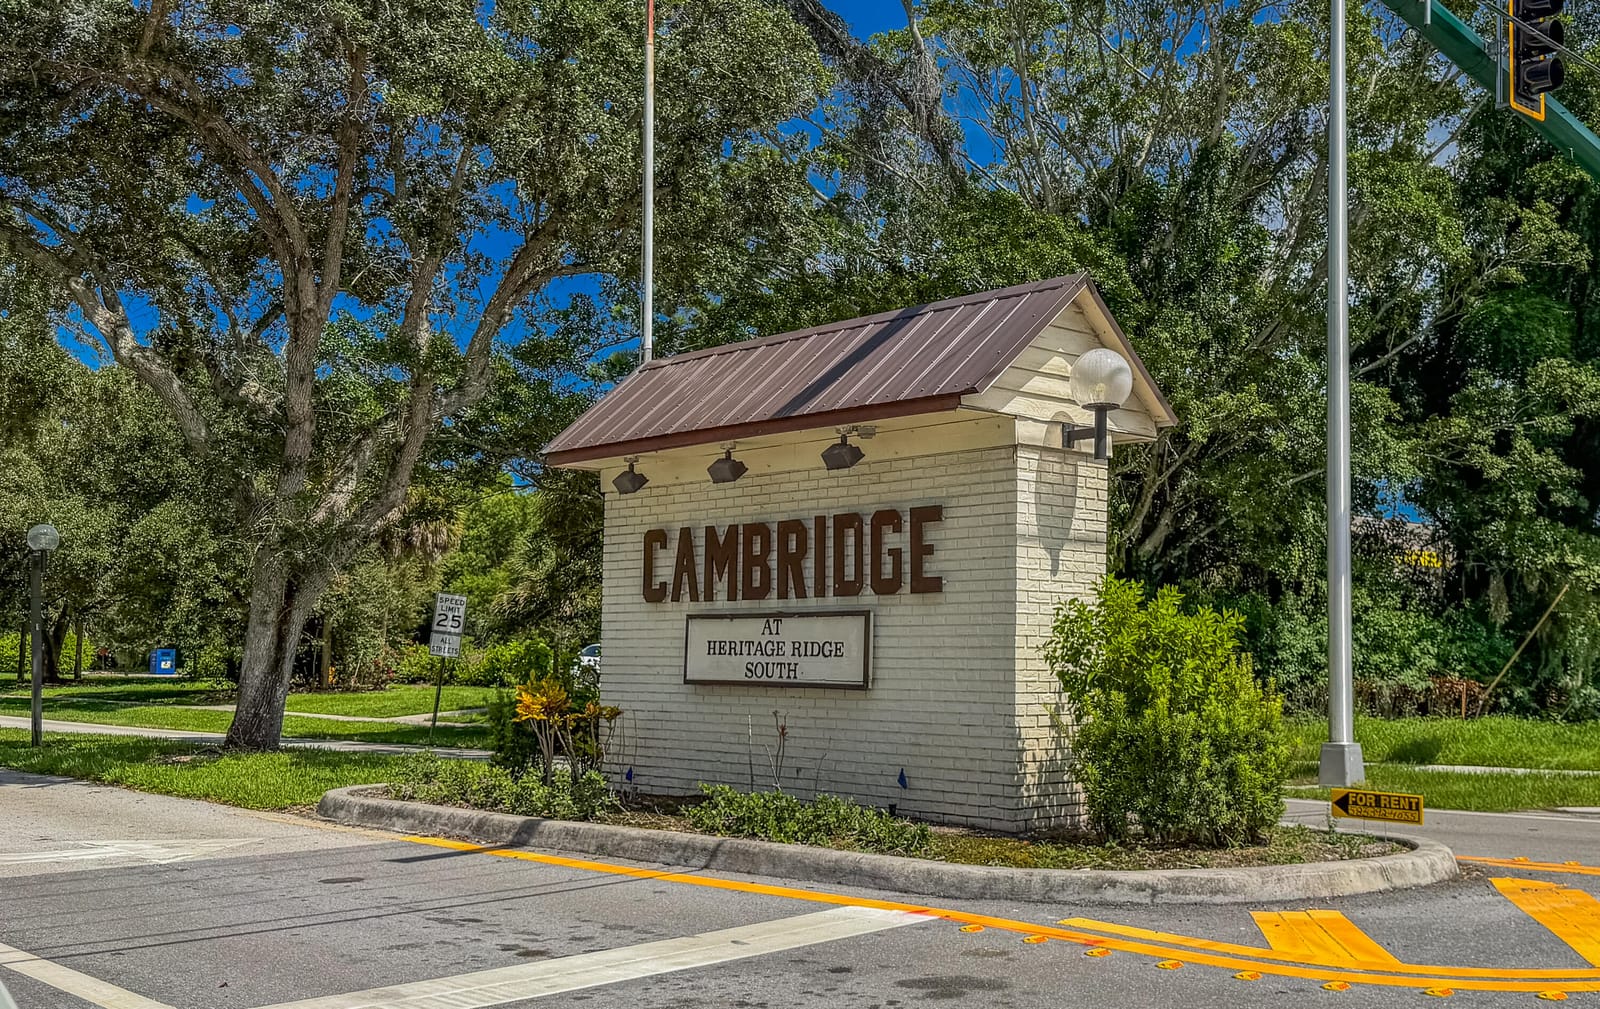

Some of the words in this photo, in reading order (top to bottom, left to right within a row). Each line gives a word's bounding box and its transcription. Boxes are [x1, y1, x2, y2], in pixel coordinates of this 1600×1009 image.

[642, 504, 943, 603] CAMBRIDGE
[439, 597, 465, 606] SPEED
[440, 605, 460, 614] LIMIT
[436, 613, 462, 629] 25
[761, 618, 783, 636] AT
[440, 637, 452, 645] ALL
[706, 640, 786, 657] HERITAGE
[791, 641, 845, 658] RIDGE
[431, 646, 459, 655] STREETS
[744, 662, 799, 680] SOUTH
[1348, 793, 1376, 807] FOR
[1380, 795, 1418, 810] RENT
